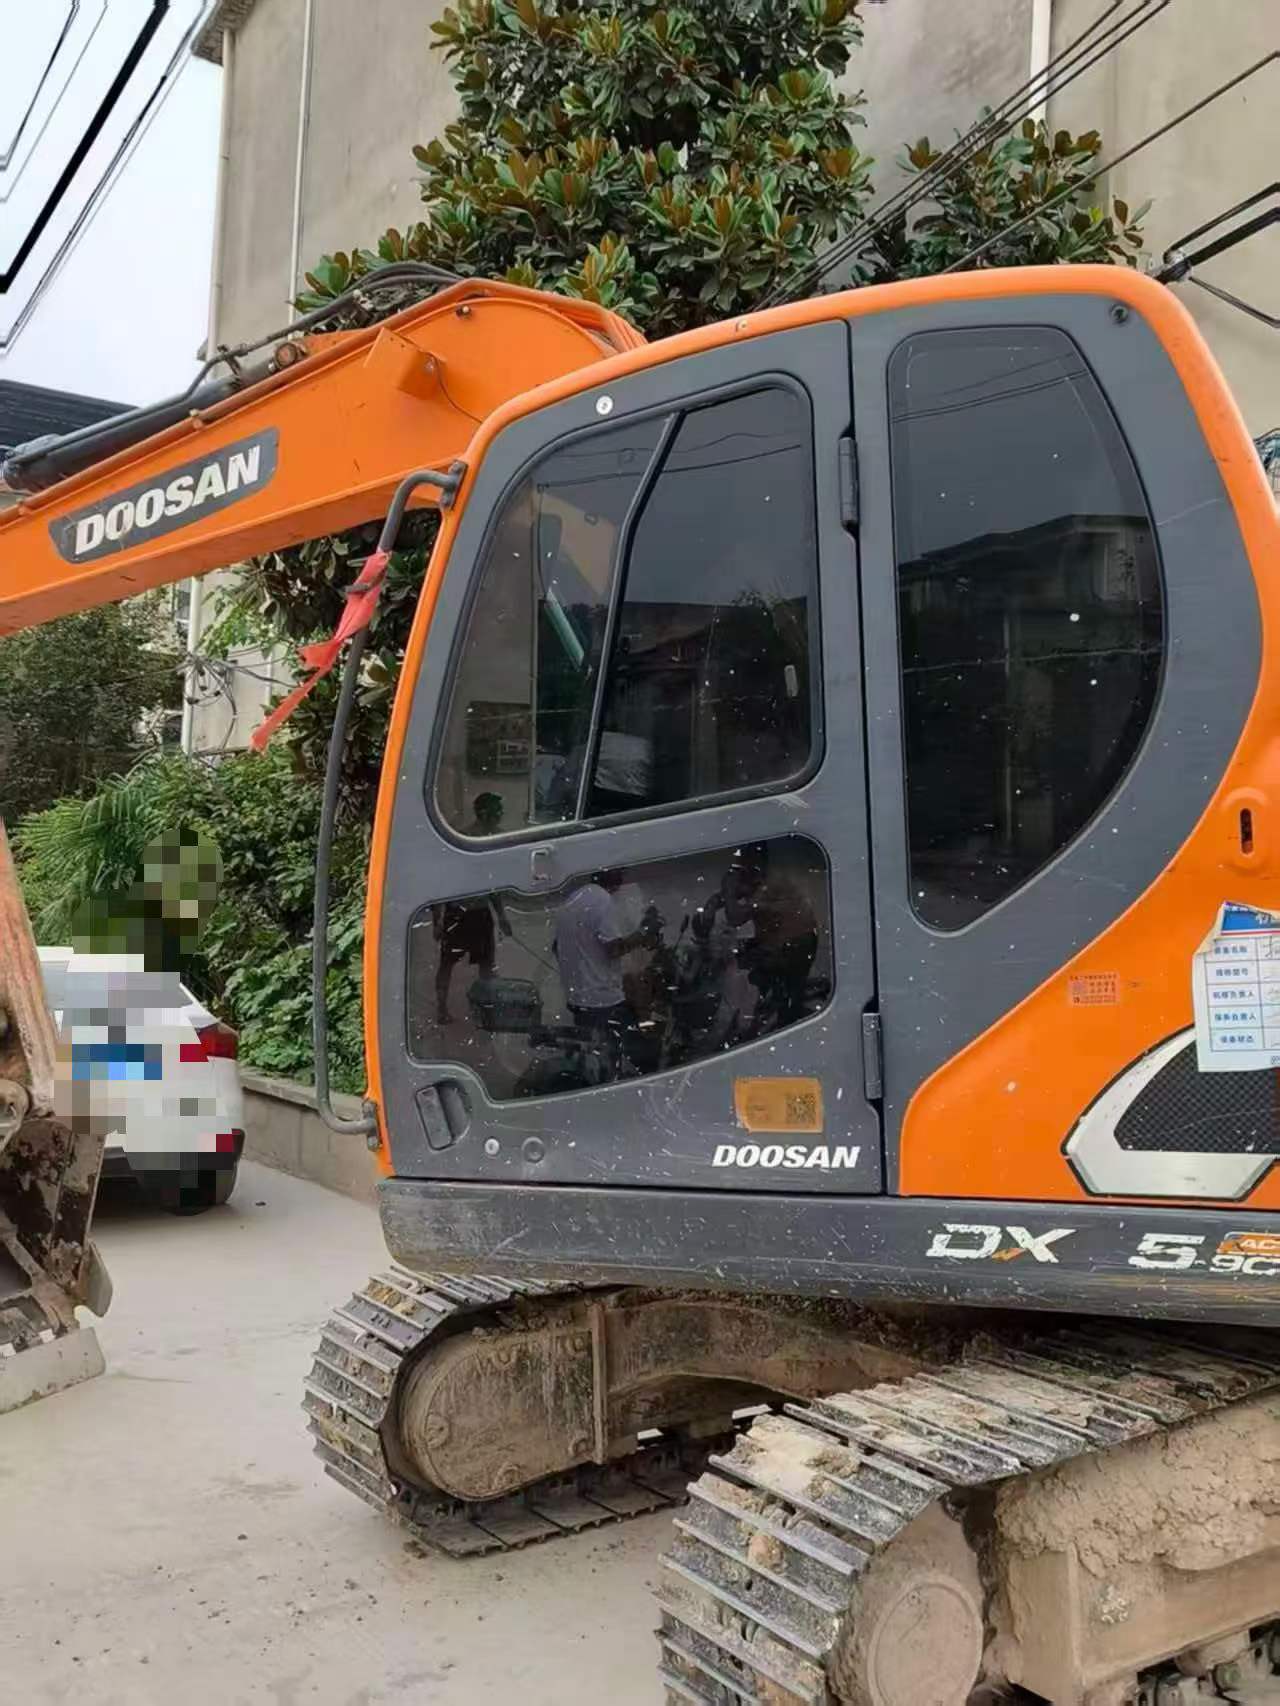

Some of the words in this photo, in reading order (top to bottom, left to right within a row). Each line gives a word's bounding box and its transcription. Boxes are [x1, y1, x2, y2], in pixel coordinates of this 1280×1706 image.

[74, 445, 261, 555] DOOSAN
[712, 1145, 860, 1169] DOOSAN
[926, 1223, 1076, 1263] DX
